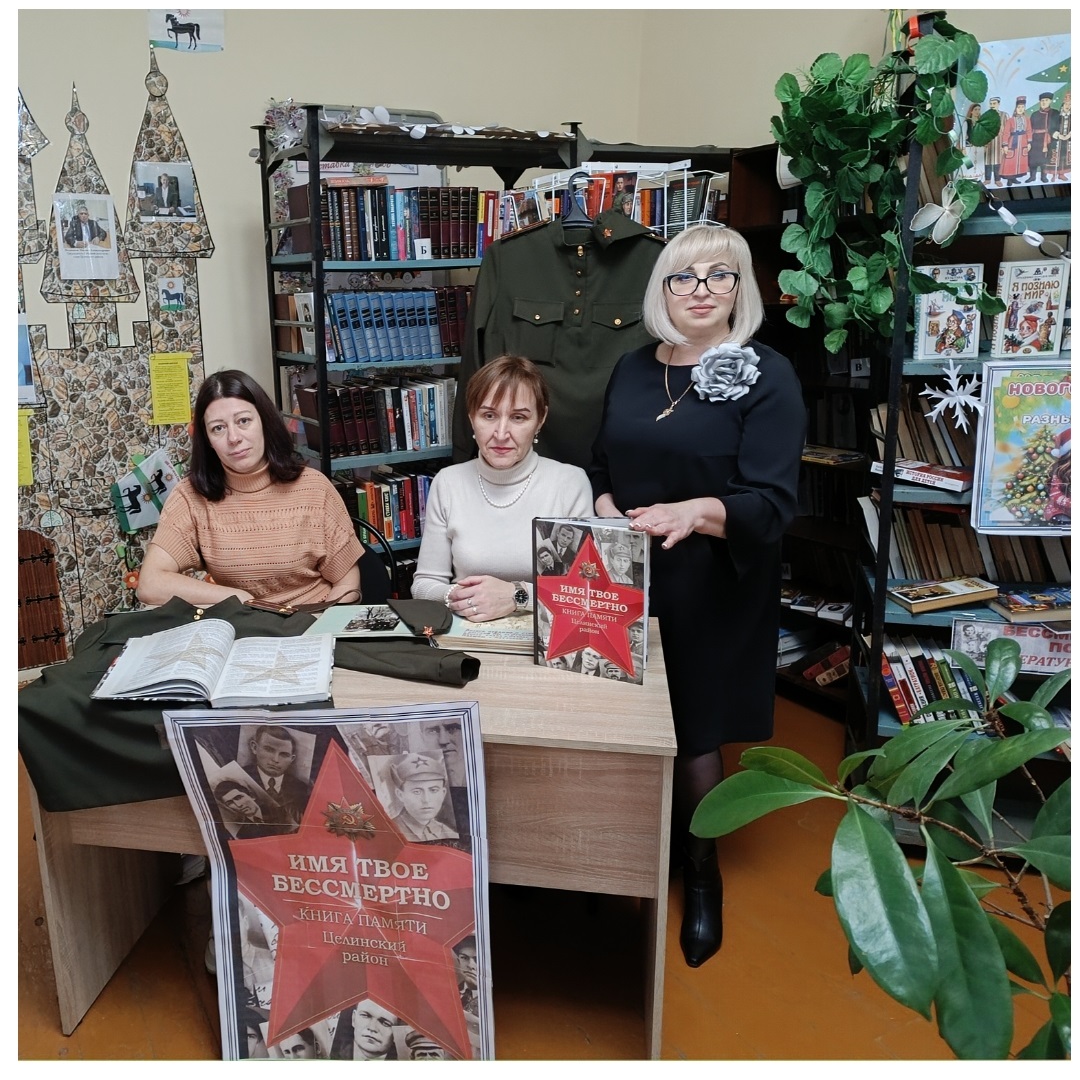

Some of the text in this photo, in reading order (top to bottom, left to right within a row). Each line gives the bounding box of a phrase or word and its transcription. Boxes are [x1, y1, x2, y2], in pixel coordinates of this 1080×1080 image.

[420, 246, 428, 254] Б
[1012, 279, 1060, 292] Я ПОЗНАЮ
[1024, 289, 1046, 300] МИР
[856, 364, 862, 372] В
[926, 474, 944, 482] РОССИИ
[560, 584, 620, 601] ИМЯ ТВОЕ
[552, 594, 628, 613] БЕССМЕРТНО
[562, 608, 618, 623] КНИГА ПАМЯТИ
[571, 618, 608, 630] Целинский
[579, 626, 600, 635] район
[1003, 625, 1071, 640] БЕССМ
[288, 854, 430, 881] ИМЯ ТВОЕ
[272, 874, 452, 910] БЕССМЕРТНО
[298, 908, 428, 936] КНИГА ПАМЯТИ
[322, 930, 406, 953] Целинский
[342, 951, 389, 967] район
